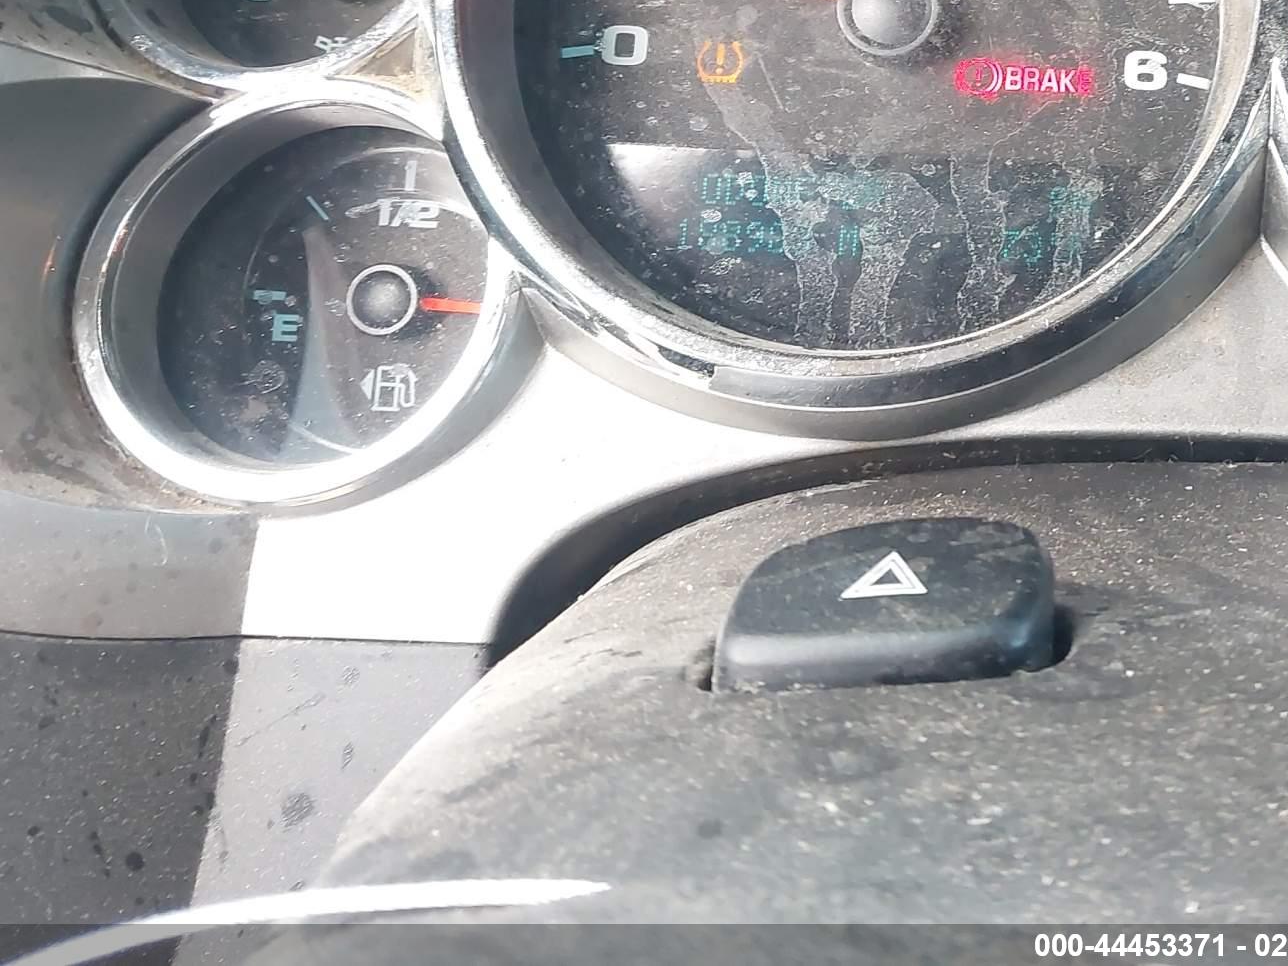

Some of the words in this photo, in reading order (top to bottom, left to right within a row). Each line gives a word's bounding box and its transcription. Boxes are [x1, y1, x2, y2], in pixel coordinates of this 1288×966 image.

[601, 25, 649, 66] 0
[1005, 66, 1093, 94] BRAKE
[1124, 50, 1167, 91] 6
[377, 199, 441, 229] 1/2
[273, 313, 303, 341] E
